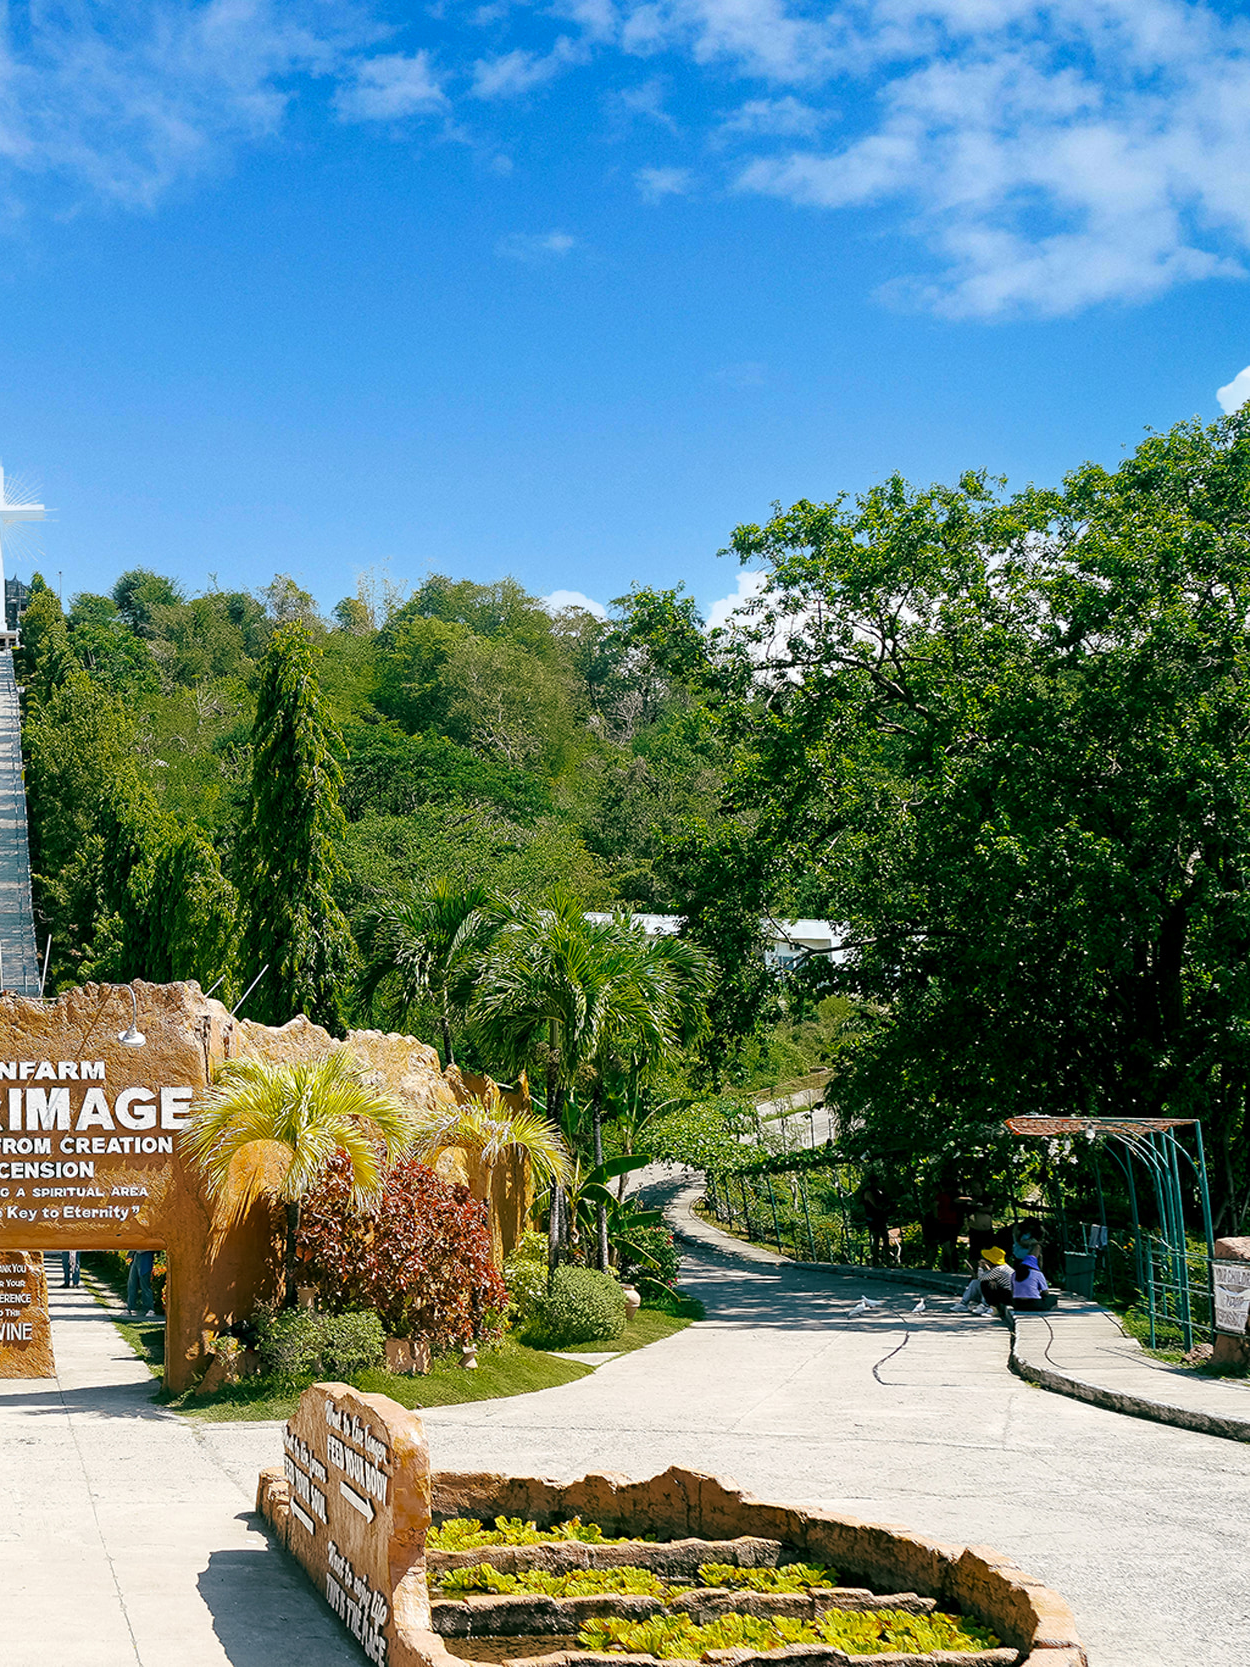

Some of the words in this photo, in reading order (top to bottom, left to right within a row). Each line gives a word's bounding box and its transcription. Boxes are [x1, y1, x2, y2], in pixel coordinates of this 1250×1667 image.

[59, 1137, 173, 1154] CREATION
[16, 1187, 26, 1198] A
[32, 1187, 105, 1198] SPIRITUAL
[111, 1186, 149, 1197] AREA
[6, 1206, 38, 1222] Key
[42, 1206, 59, 1219] to
[327, 1433, 345, 1472] FEED
[344, 1445, 366, 1489] YOUR
[365, 1460, 388, 1506] BODY
